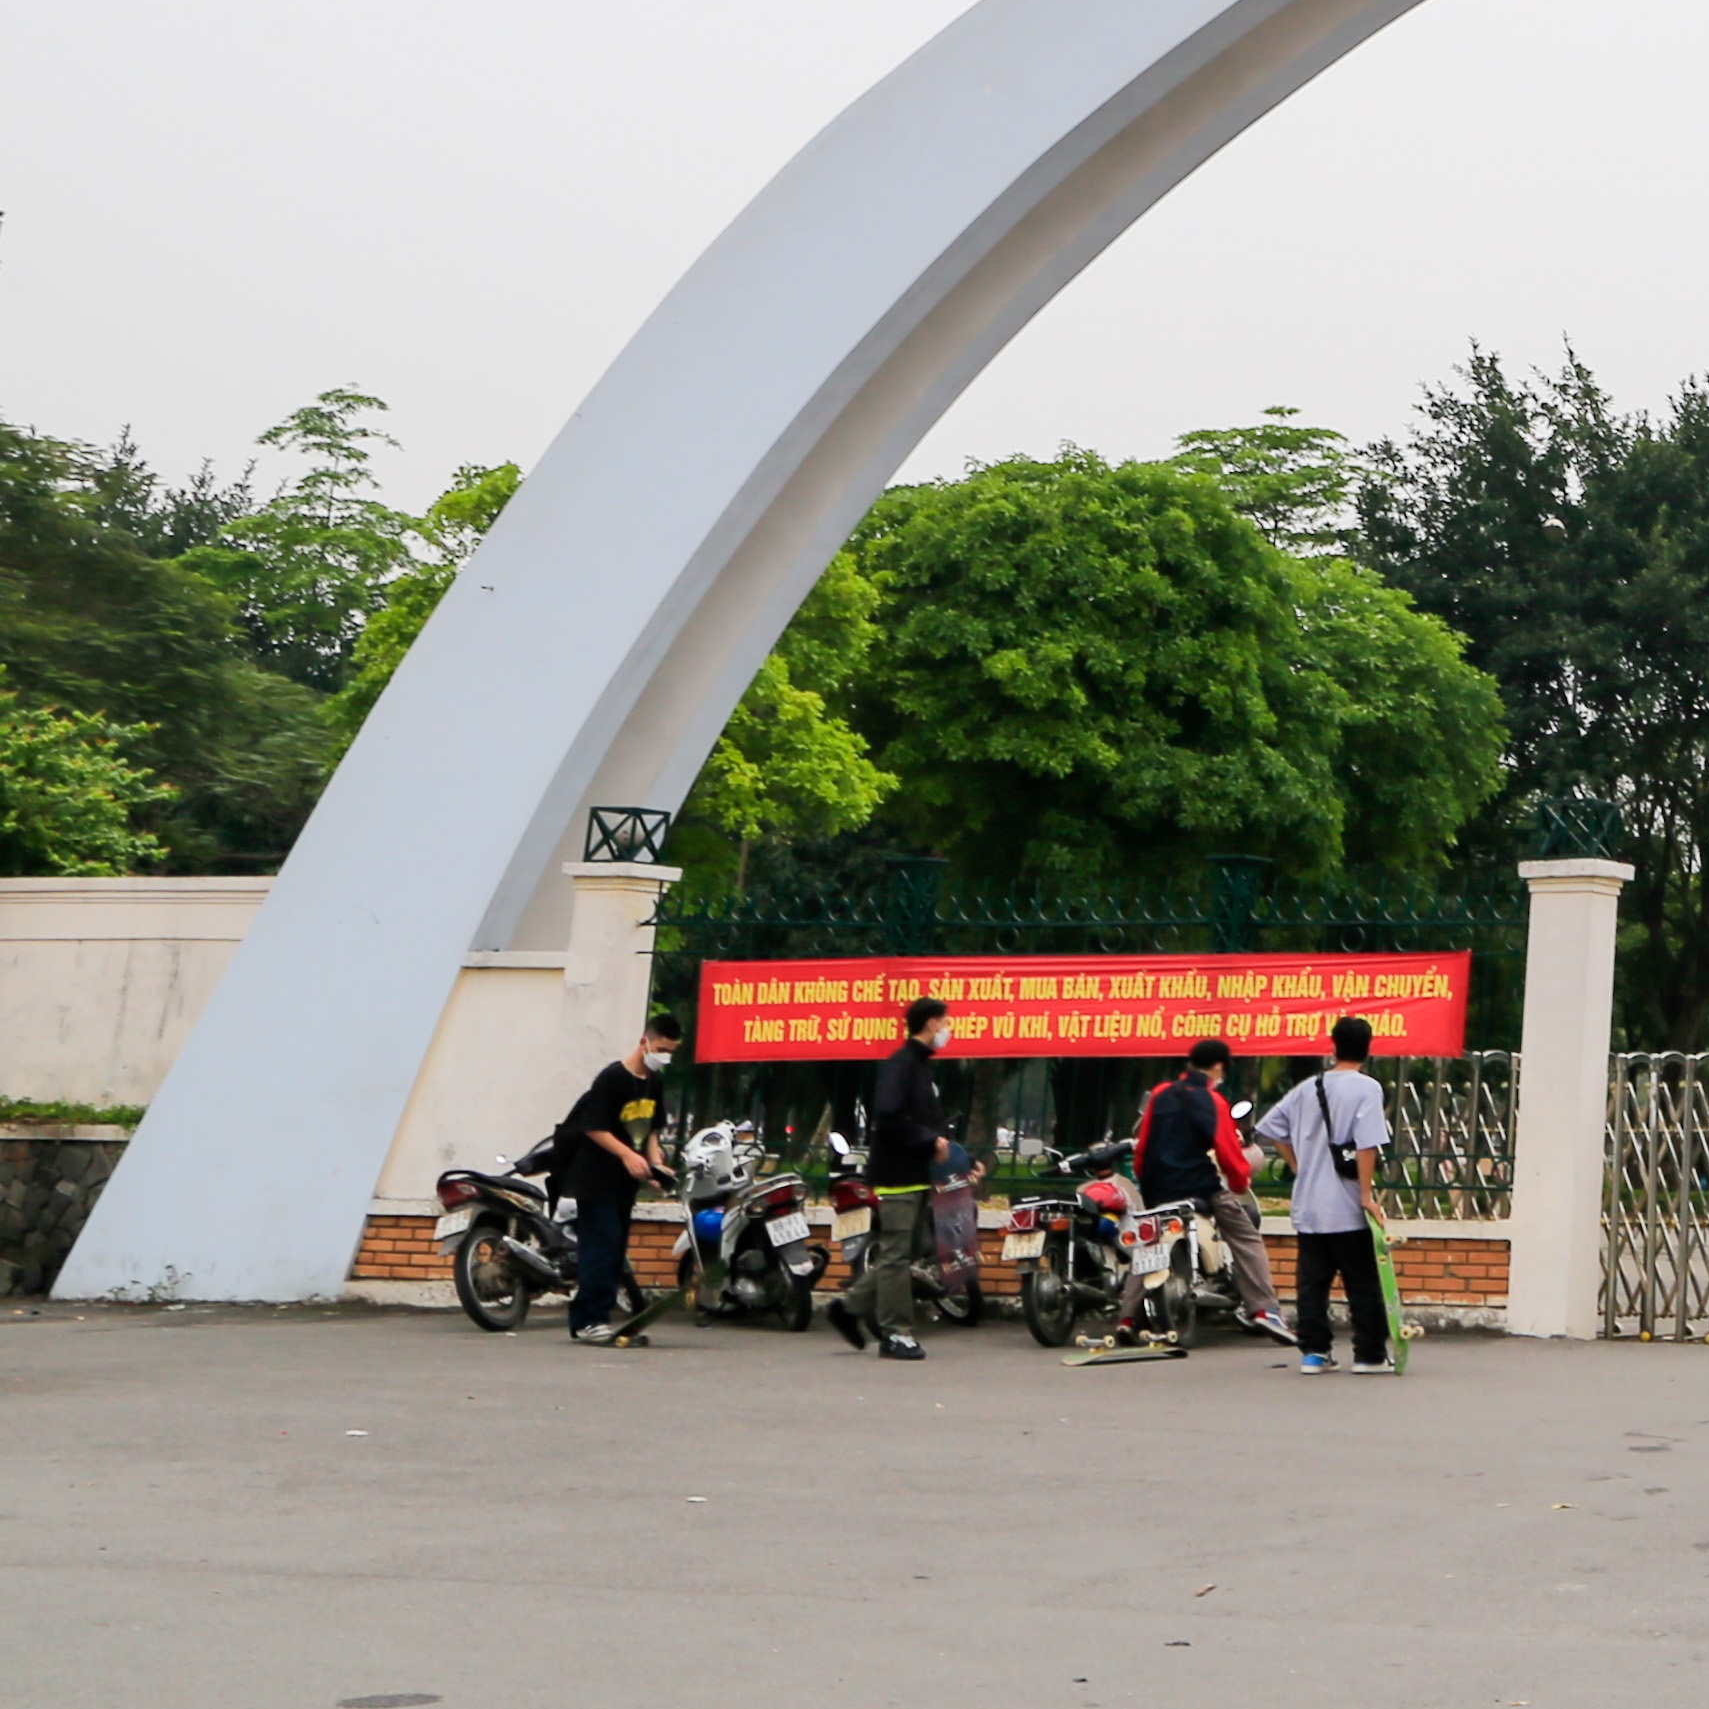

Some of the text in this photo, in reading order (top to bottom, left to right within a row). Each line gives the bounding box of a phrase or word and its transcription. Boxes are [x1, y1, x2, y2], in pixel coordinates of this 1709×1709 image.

[713, 979, 753, 1006] TOÀN
[757, 978, 789, 1005] DÂN
[794, 976, 848, 1004] KHÔNG
[852, 973, 886, 1003] CHẾ
[928, 972, 964, 1001] SẢN
[967, 970, 1015, 1003] XUẤT,
[1019, 977, 1058, 1000] MUA
[1062, 972, 1103, 1002] BÁN,
[1108, 969, 1155, 1000] XUẤT
[1158, 968, 1212, 1000] KHẨU,
[1217, 970, 1268, 1003] NHẬP
[1271, 966, 1326, 1000] KHẨU,
[1332, 970, 1370, 1003] VẬN
[1373, 965, 1453, 1001] CHUYỂN,
[743, 1015, 785, 1042] TÀNG
[788, 1014, 822, 1044] TRỮ,
[826, 1011, 850, 1041] SỬ
[852, 1017, 897, 1046] DỤNG
[992, 1014, 1018, 1039] VŨ
[1018, 1010, 1053, 1041] KHÍ,
[1058, 1014, 1092, 1043] VẬT
[1094, 1013, 1132, 1042] LIỆU
[1136, 1005, 1167, 1040] NỔ,
[1171, 1010, 1221, 1038] CÔNG
[1225, 1013, 1250, 1042] CỤ
[1255, 1005, 1281, 1037] HỖ
[1285, 1011, 1320, 1042] TRỢ
